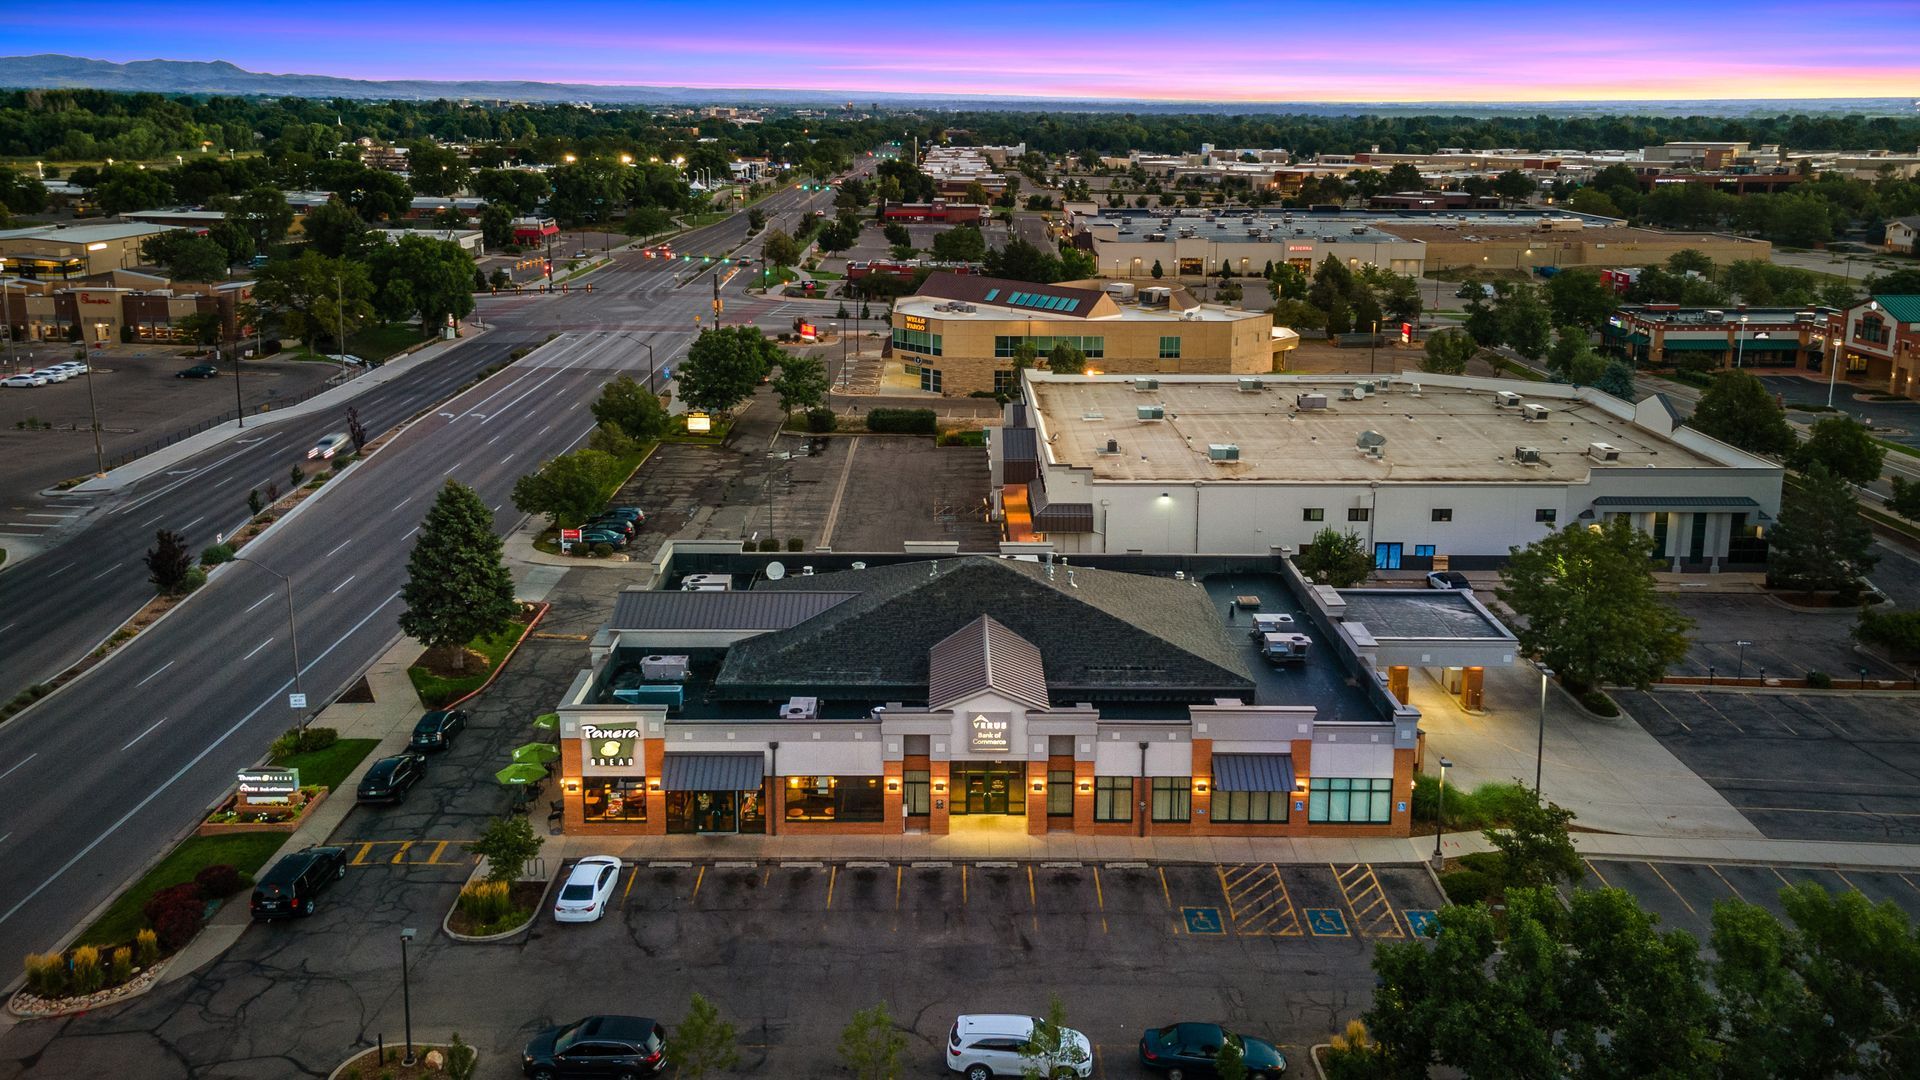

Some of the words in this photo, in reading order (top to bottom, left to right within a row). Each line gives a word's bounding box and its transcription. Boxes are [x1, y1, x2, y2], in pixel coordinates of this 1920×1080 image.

[906, 316, 926, 324] WELLS
[906, 323, 925, 331] FARGO
[973, 722, 1007, 730] VERUS
[581, 725, 639, 739] Panera
[590, 758, 634, 766] BREAD
